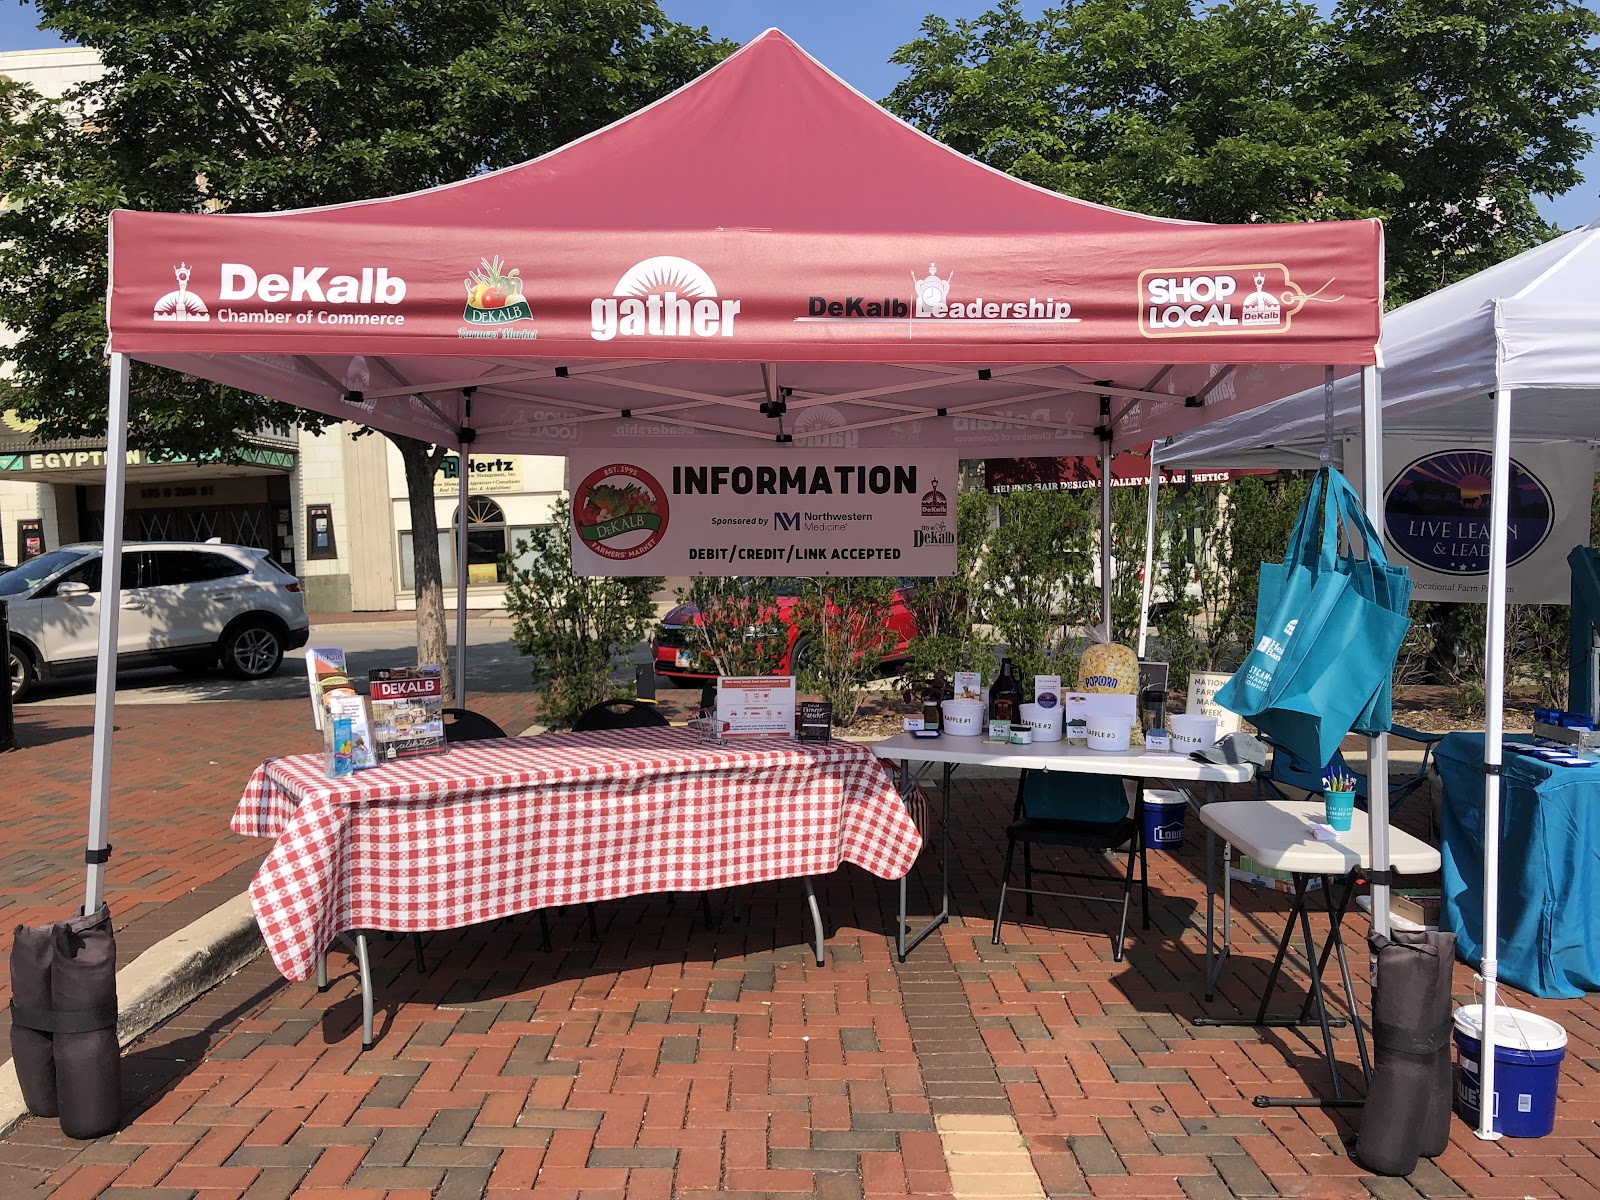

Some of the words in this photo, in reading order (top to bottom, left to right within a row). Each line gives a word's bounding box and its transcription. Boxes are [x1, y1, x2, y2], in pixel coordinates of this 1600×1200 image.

[219, 262, 406, 306] DeKalb
[1147, 275, 1236, 304] SHOP
[808, 295, 908, 318] DeKalb
[914, 295, 1072, 322] Leadership
[1148, 302, 1239, 329] LOCAL
[1244, 311, 1279, 320] DeKalb
[217, 308, 293, 325] Chamber
[296, 309, 313, 325] of
[318, 312, 404, 327] Commerce
[590, 292, 740, 342] gather
[30, 449, 141, 470] EGYPTIN
[603, 467, 619, 476] EST.
[620, 466, 639, 476] 1995
[672, 464, 918, 496] INFORMATION
[1060, 479, 1095, 490] DESIGN
[711, 517, 757, 527] Sponsored
[758, 517, 769, 527] by
[804, 511, 873, 521] Northwestern
[804, 522, 847, 532] Medicine
[1408, 520, 1452, 538] LIVE
[1458, 521, 1518, 540] LEAN
[912, 529, 955, 548] DeKalb
[628, 539, 656, 557] MARKET
[831, 547, 901, 561] ACCEPTED
[1433, 542, 1447, 555] &
[1412, 581, 1455, 591] Vocational
[1457, 583, 1478, 592] Farm
[1246, 674, 1270, 687] CHAMB
[1249, 665, 1272, 681] SYCAM
[382, 680, 435, 696] DEKALB
[1085, 675, 1119, 690] POPCORN
[1194, 678, 1226, 687] NATION
[1200, 708, 1223, 717] WEEK
